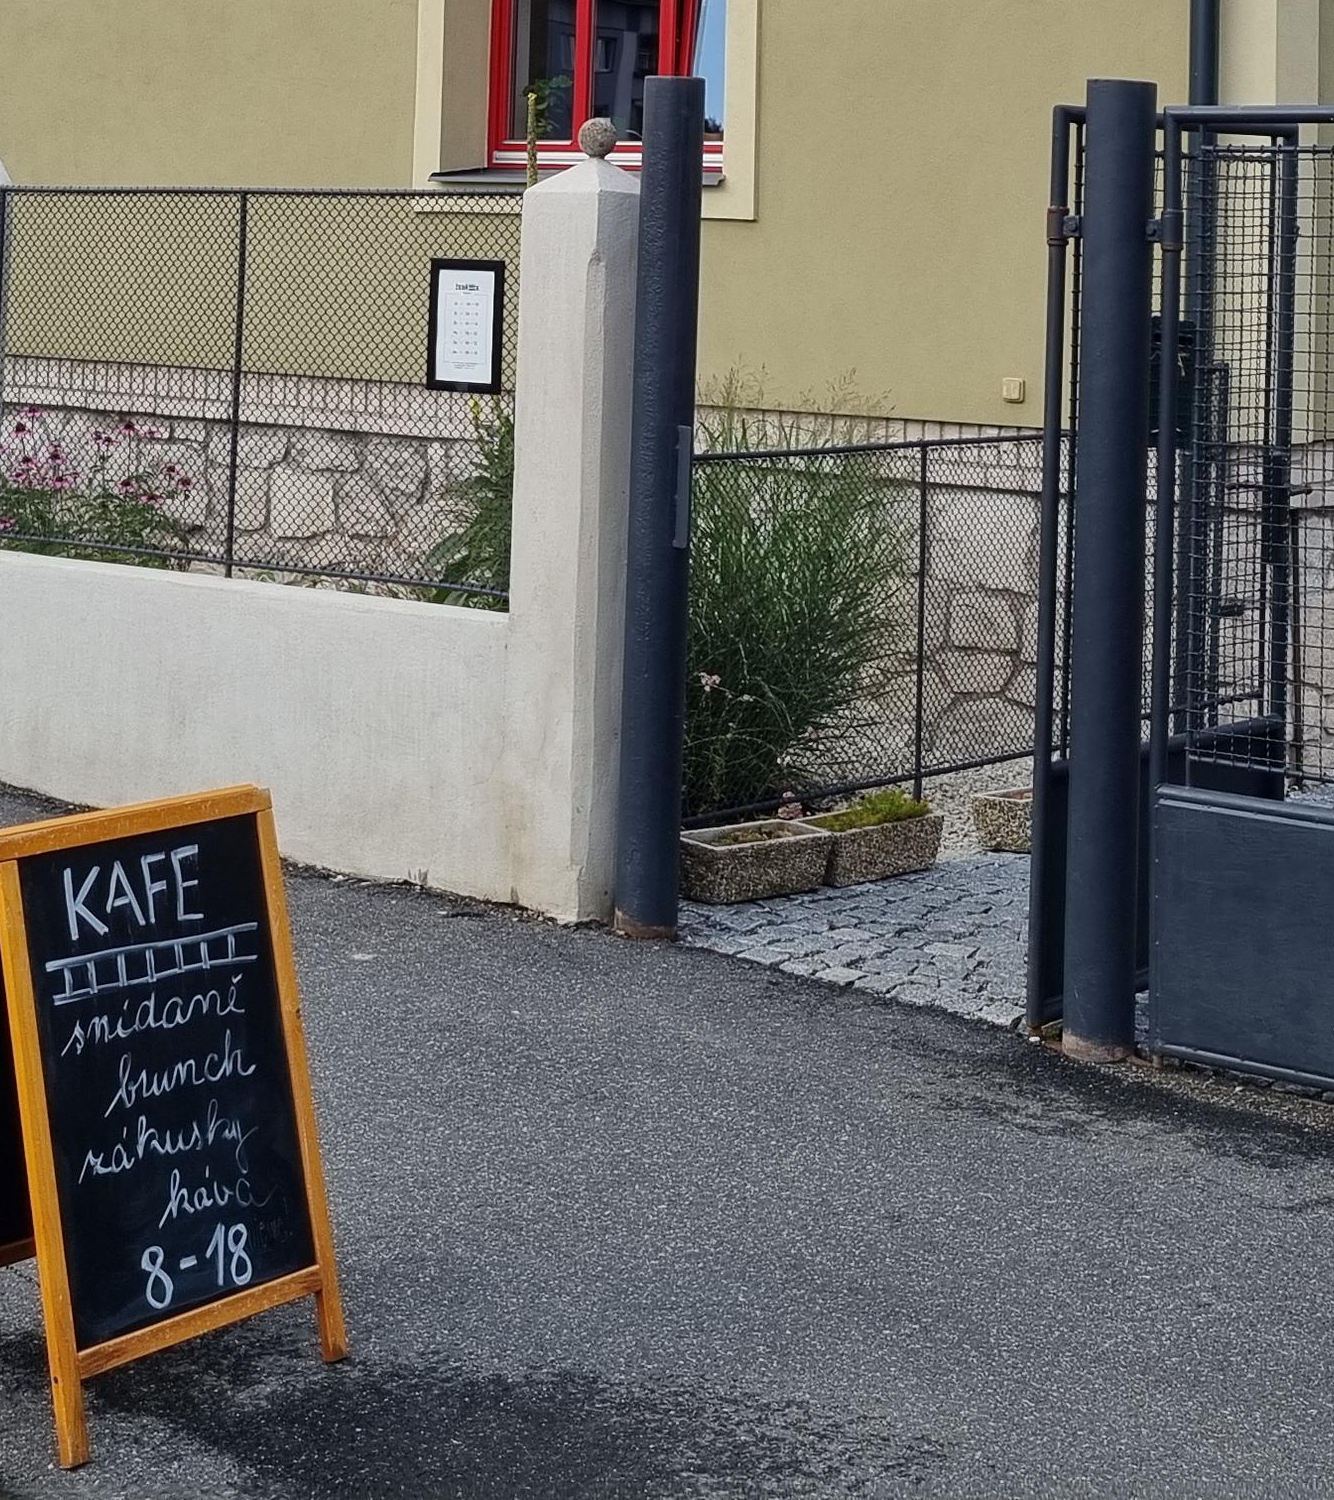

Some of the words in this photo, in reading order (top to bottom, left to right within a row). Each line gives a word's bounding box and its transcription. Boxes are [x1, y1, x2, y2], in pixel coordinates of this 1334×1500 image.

[63, 844, 205, 941] KAFE
[61, 973, 245, 1057] snídaně
[104, 1028, 257, 1117] brunch
[78, 1098, 260, 1184] zákusky
[158, 1165, 278, 1229] káva
